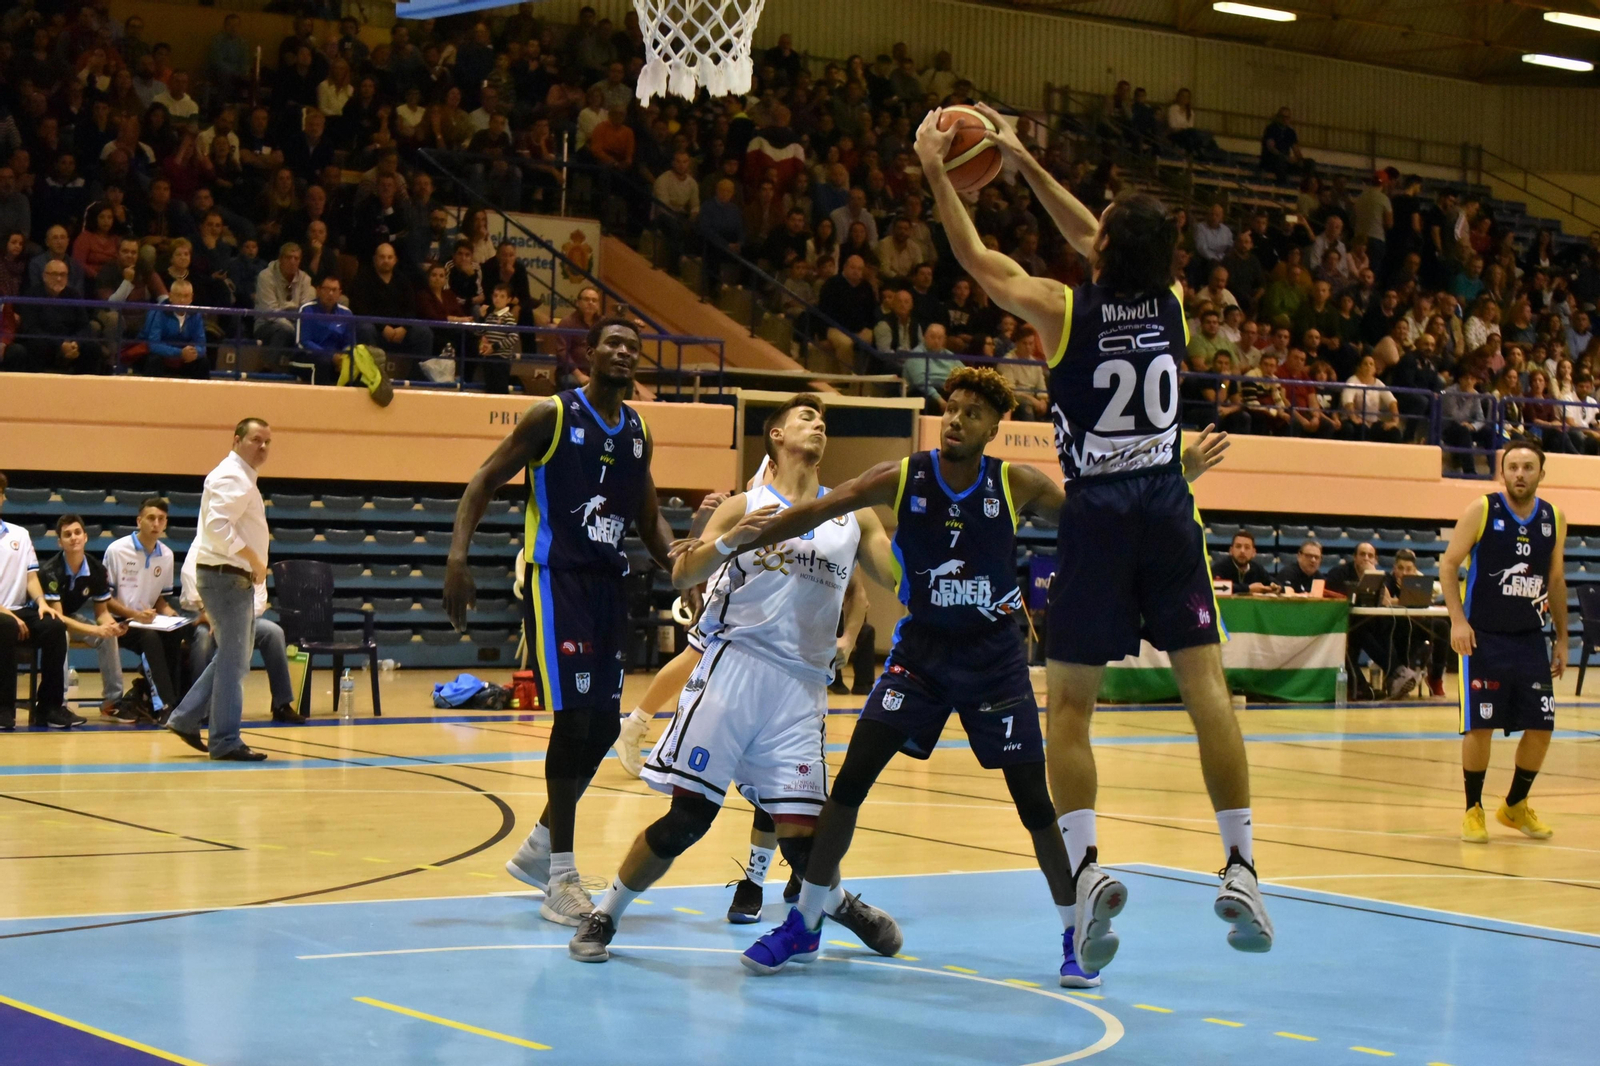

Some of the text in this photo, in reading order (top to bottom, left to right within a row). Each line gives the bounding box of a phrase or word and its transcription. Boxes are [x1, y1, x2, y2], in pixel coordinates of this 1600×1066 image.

[1093, 353, 1178, 432] 20
[1005, 433, 1049, 448] PRENS
[600, 454, 615, 465] vive
[600, 465, 606, 484] 1
[944, 518, 964, 529] vive
[949, 530, 960, 549] 7
[1516, 542, 1531, 556] 30
[939, 579, 991, 594] ENER
[1540, 696, 1555, 713] 30
[1001, 715, 1014, 739] 7
[1003, 741, 1023, 752] vive
[688, 745, 710, 773] 0
